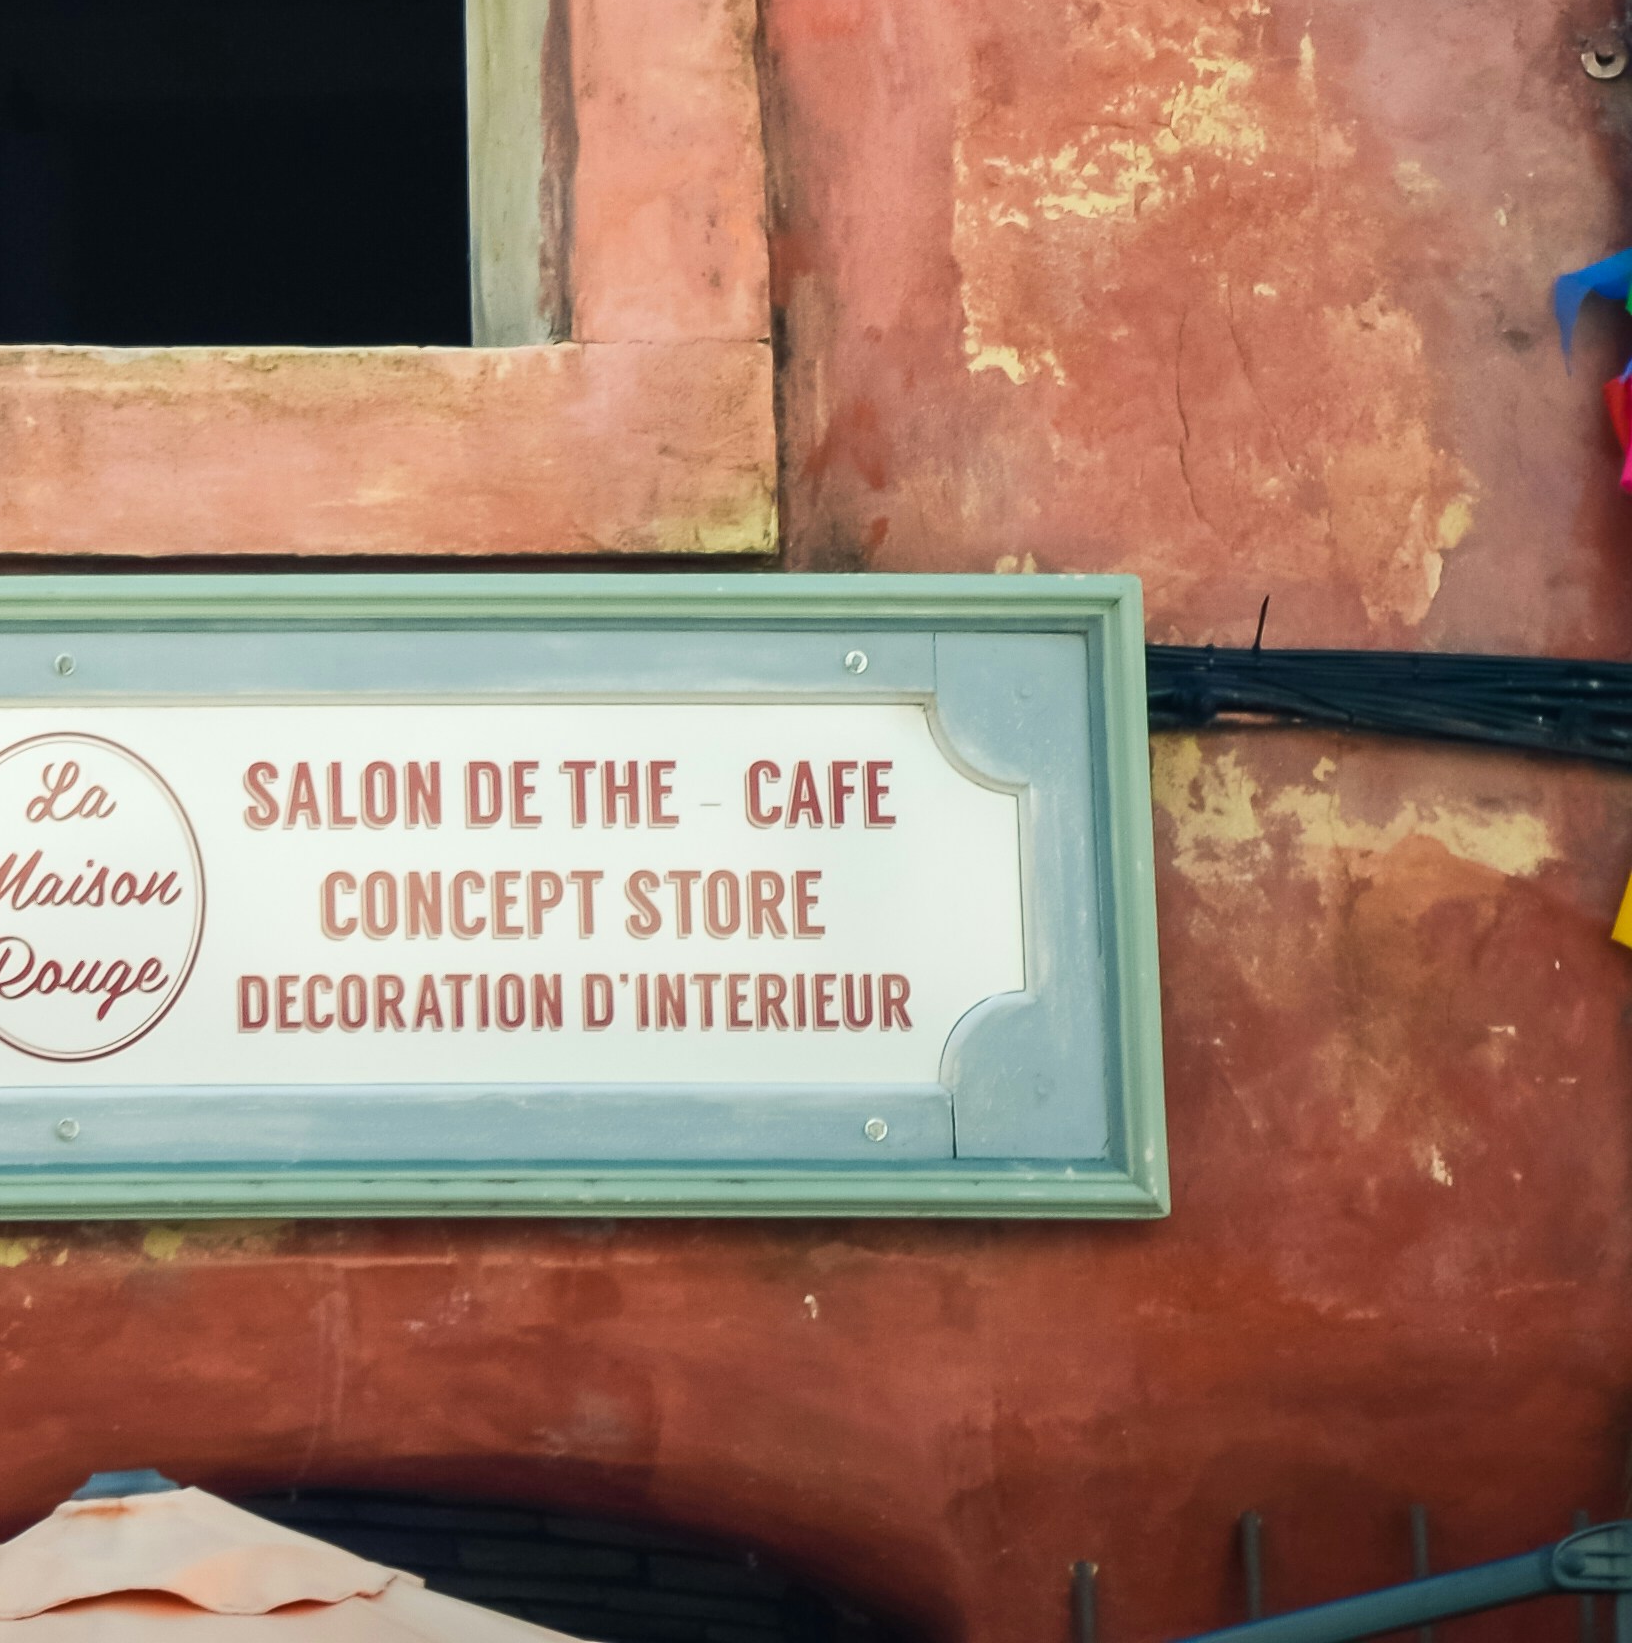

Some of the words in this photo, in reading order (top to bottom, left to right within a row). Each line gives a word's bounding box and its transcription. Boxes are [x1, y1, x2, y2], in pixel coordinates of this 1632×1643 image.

[25, 761, 117, 822] La
[243, 760, 441, 830] SALON
[464, 761, 540, 830] DE
[560, 759, 679, 829] THE
[744, 759, 897, 829] CAFE
[320, 870, 604, 940] CONCEPT
[624, 868, 826, 940] STORE
[236, 973, 564, 1033] DECORATION
[581, 973, 913, 1032] D'INTERIEUR
